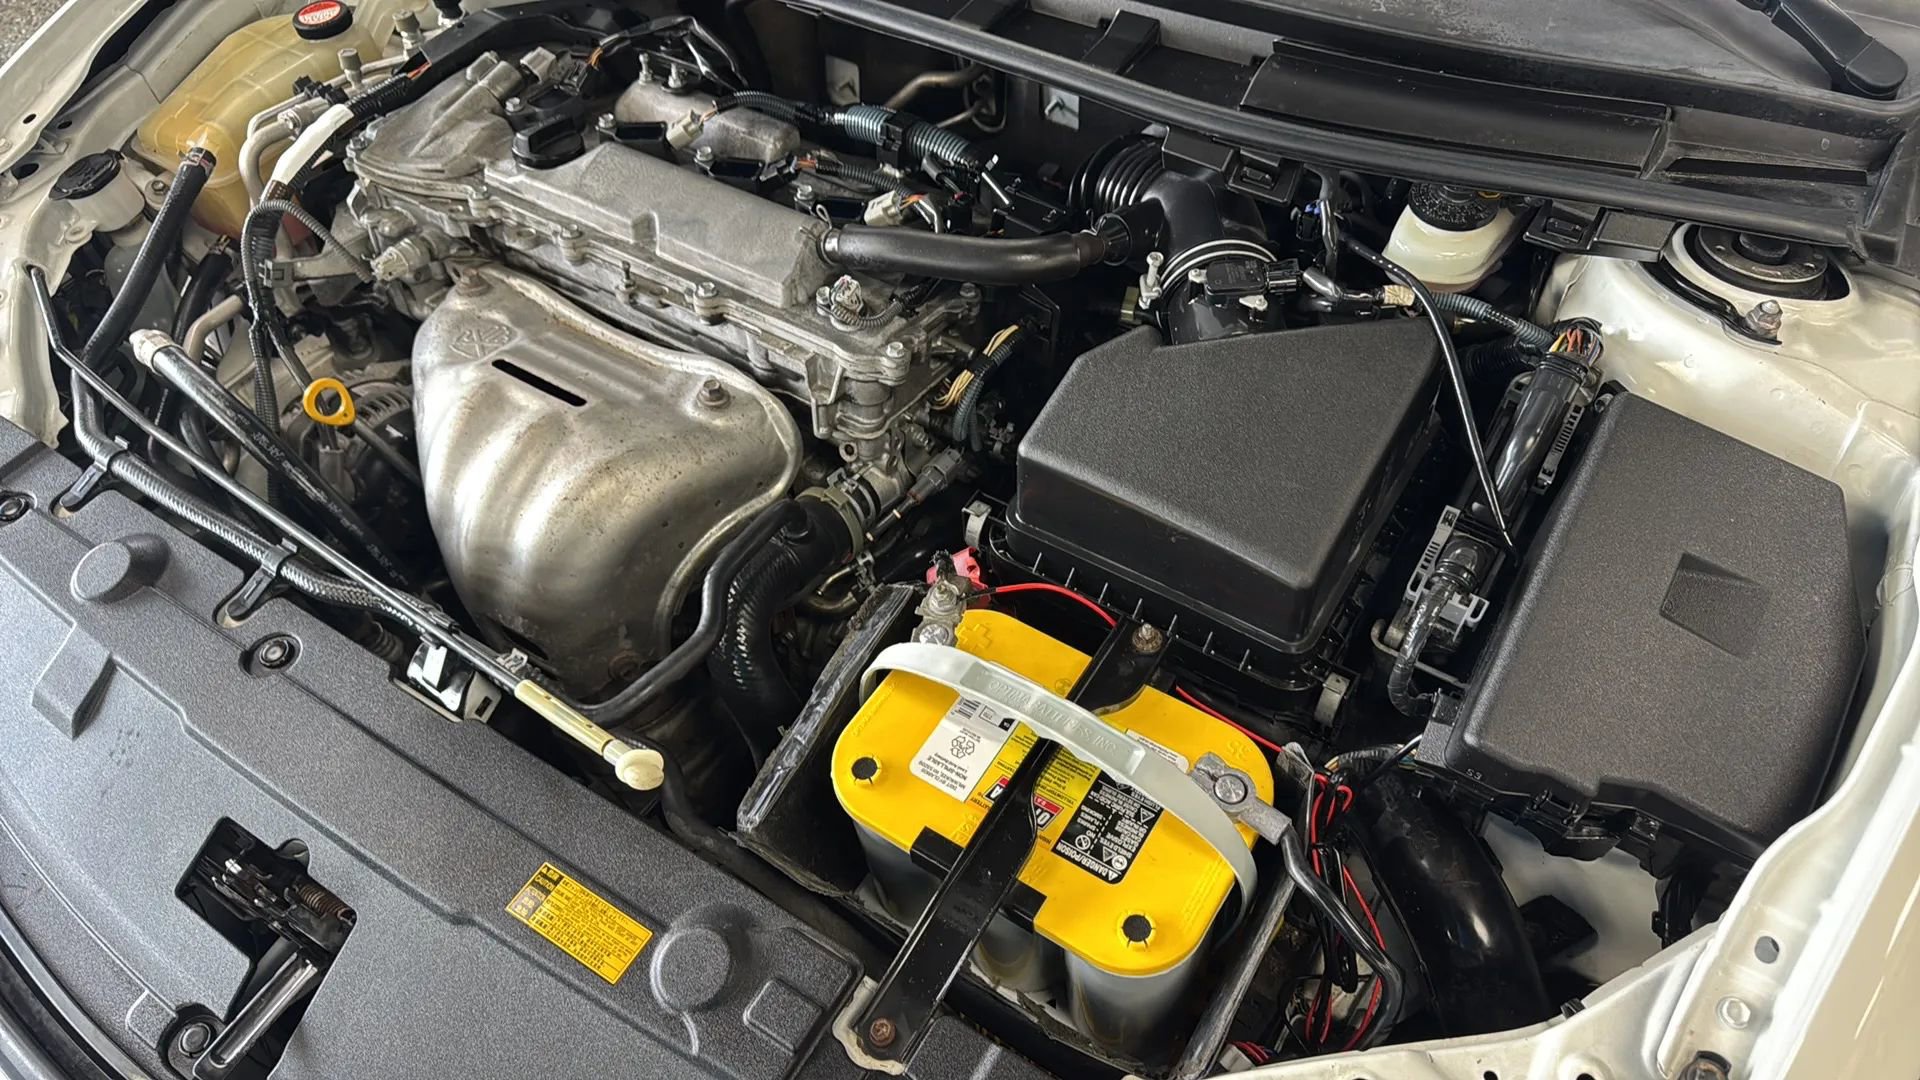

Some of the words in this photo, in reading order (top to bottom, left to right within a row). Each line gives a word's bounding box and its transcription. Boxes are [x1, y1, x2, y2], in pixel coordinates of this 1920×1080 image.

[926, 755, 967, 780] NON-SPILLABLE
[1098, 795, 1111, 805] ACID
[1079, 811, 1099, 825] FLAMES
[1080, 804, 1103, 820] SMOKING
[1076, 816, 1096, 831] SPARKS
[1113, 824, 1131, 837] CAUSE
[1084, 829, 1096, 838] NO
[1119, 833, 1139, 847] GASES
[1129, 833, 1142, 842] CAN
[1105, 831, 1136, 853] EXPLOSIVE
[1055, 841, 1108, 876] DANGER/POISON
[1112, 844, 1132, 859] SHIELD
